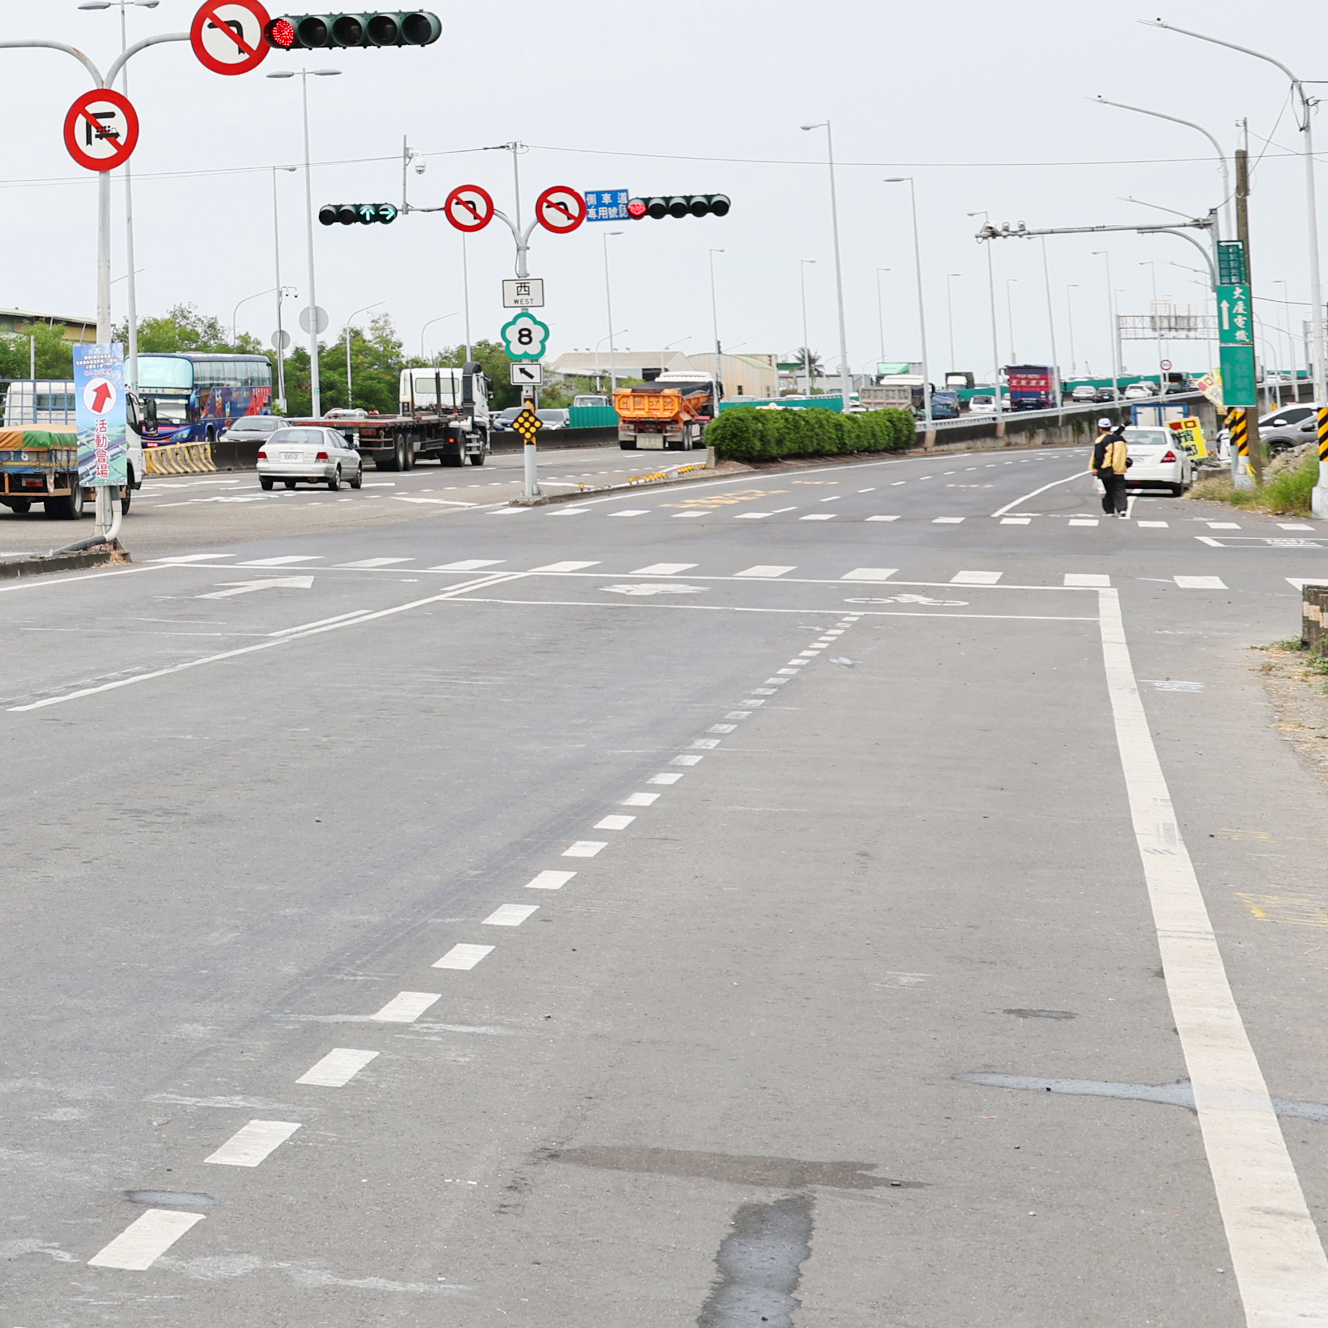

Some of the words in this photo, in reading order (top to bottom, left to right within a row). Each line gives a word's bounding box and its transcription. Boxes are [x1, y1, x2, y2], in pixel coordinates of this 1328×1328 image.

[586, 191, 629, 206] 側車道
[515, 281, 531, 296] 西
[517, 327, 533, 346] 8
[95, 418, 108, 479] 活動會場
